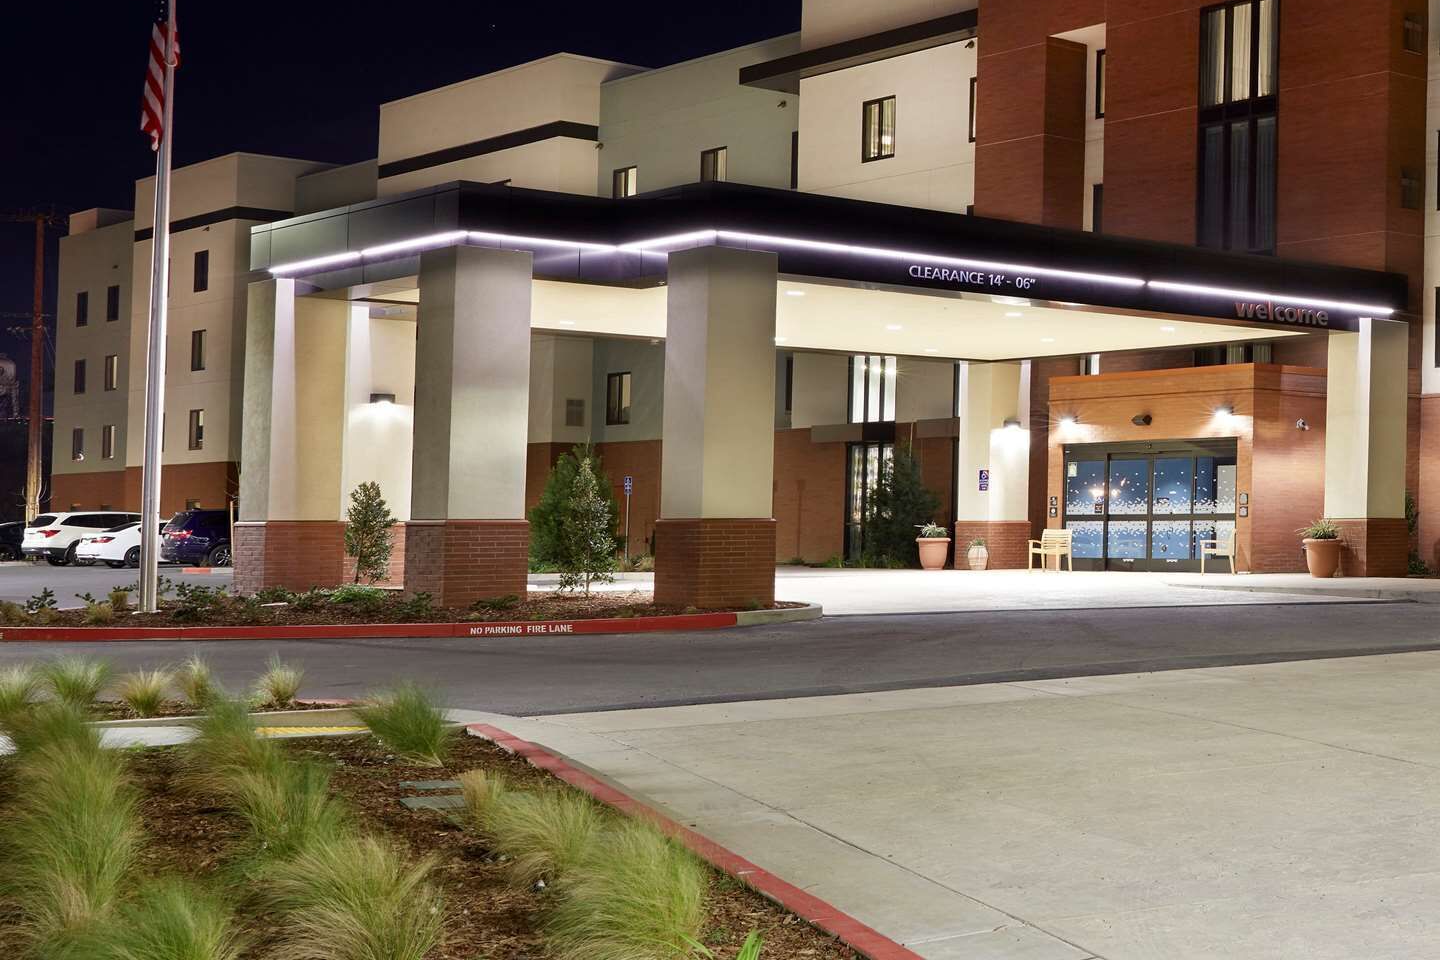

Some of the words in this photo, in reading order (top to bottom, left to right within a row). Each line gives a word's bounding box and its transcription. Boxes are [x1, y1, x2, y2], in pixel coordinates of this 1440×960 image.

[908, 265, 985, 285] CLEARANCE
[1234, 300, 1329, 326] welcome
[470, 627, 483, 635] NO
[484, 626, 522, 634] PARKING
[527, 625, 546, 633] FIRE
[549, 624, 573, 633] LANE
